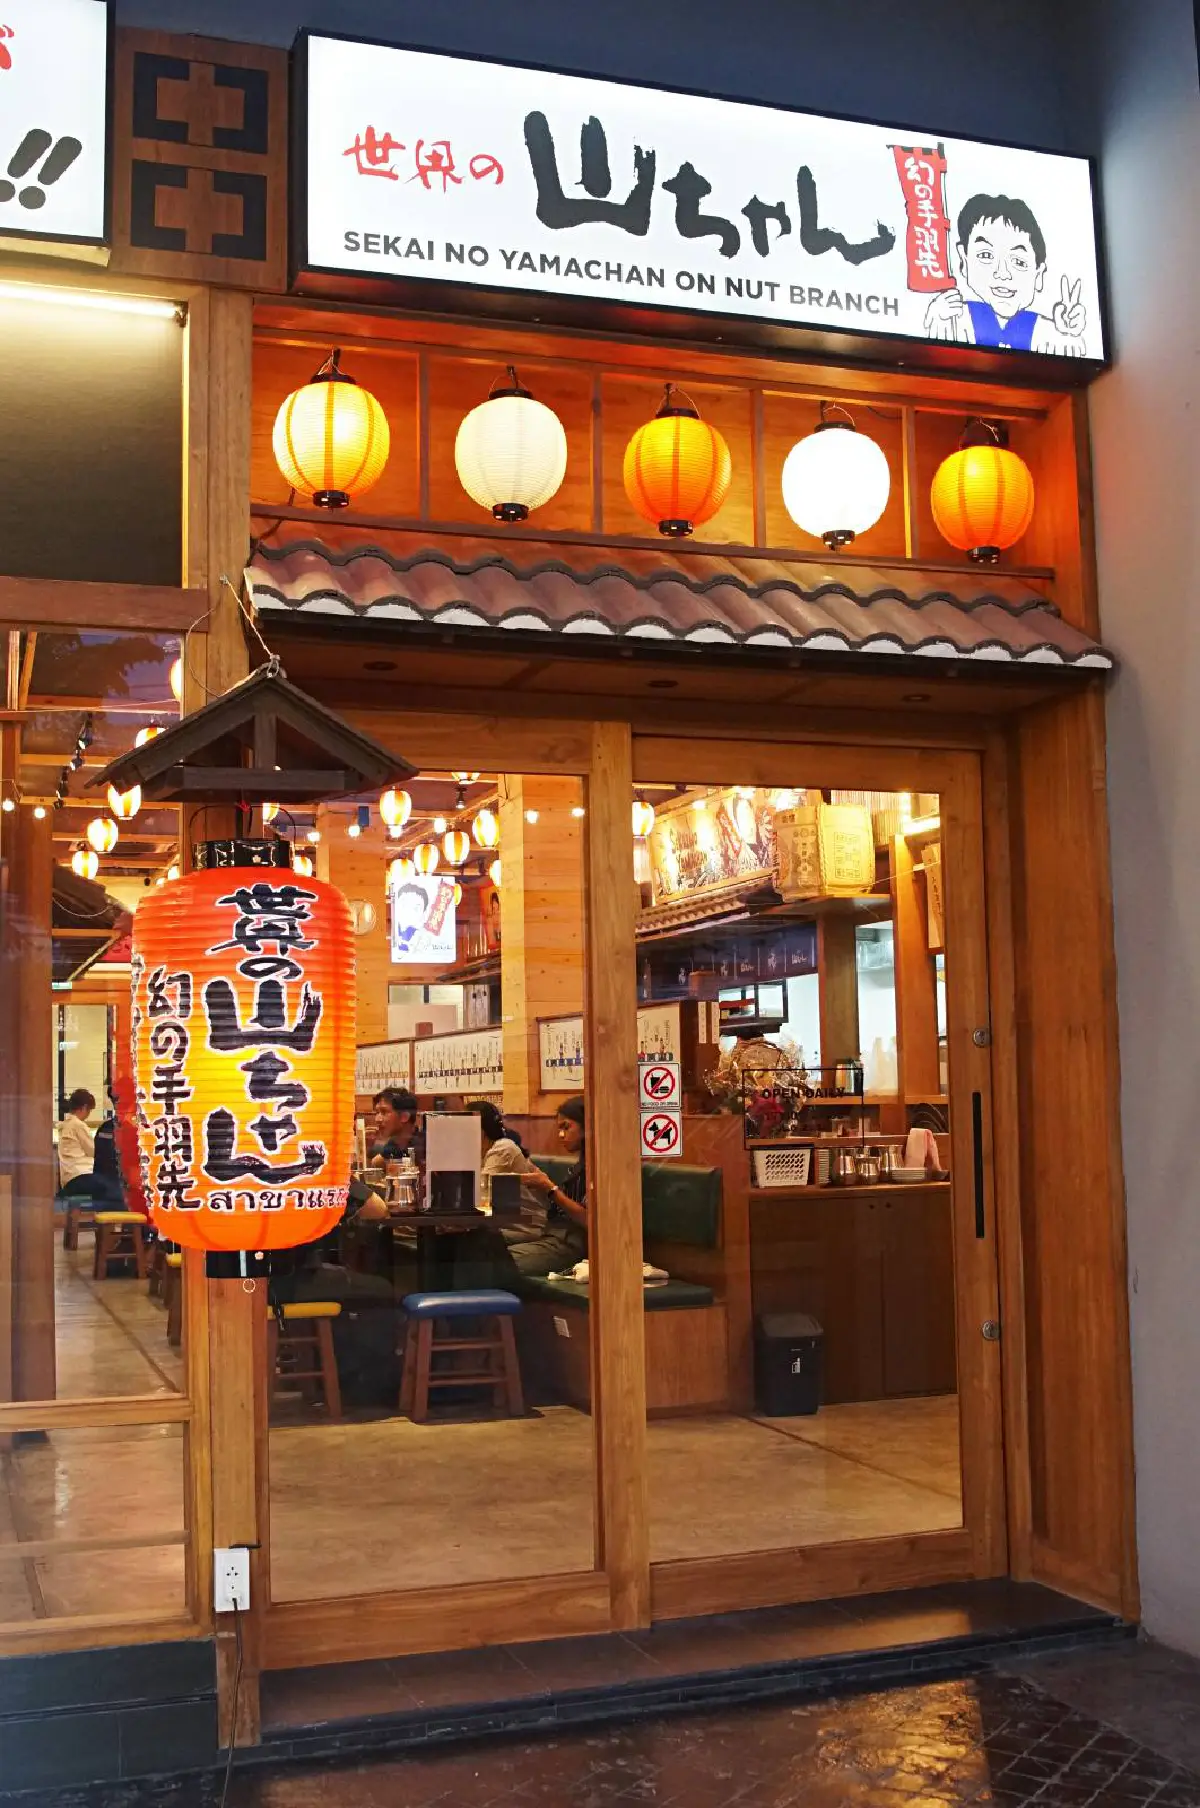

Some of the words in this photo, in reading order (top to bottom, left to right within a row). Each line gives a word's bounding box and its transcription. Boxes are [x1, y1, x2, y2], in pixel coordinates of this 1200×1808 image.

[344, 231, 434, 261] SEKAI
[445, 242, 489, 267] NO
[498, 248, 665, 290] YAMACHAN
[675, 270, 716, 295] ON
[724, 276, 781, 302] NUT
[789, 285, 899, 317] BRANCH
[904, 157, 944, 279] 幻の手羽先
[148, 964, 201, 1210] 幻の手羽先
